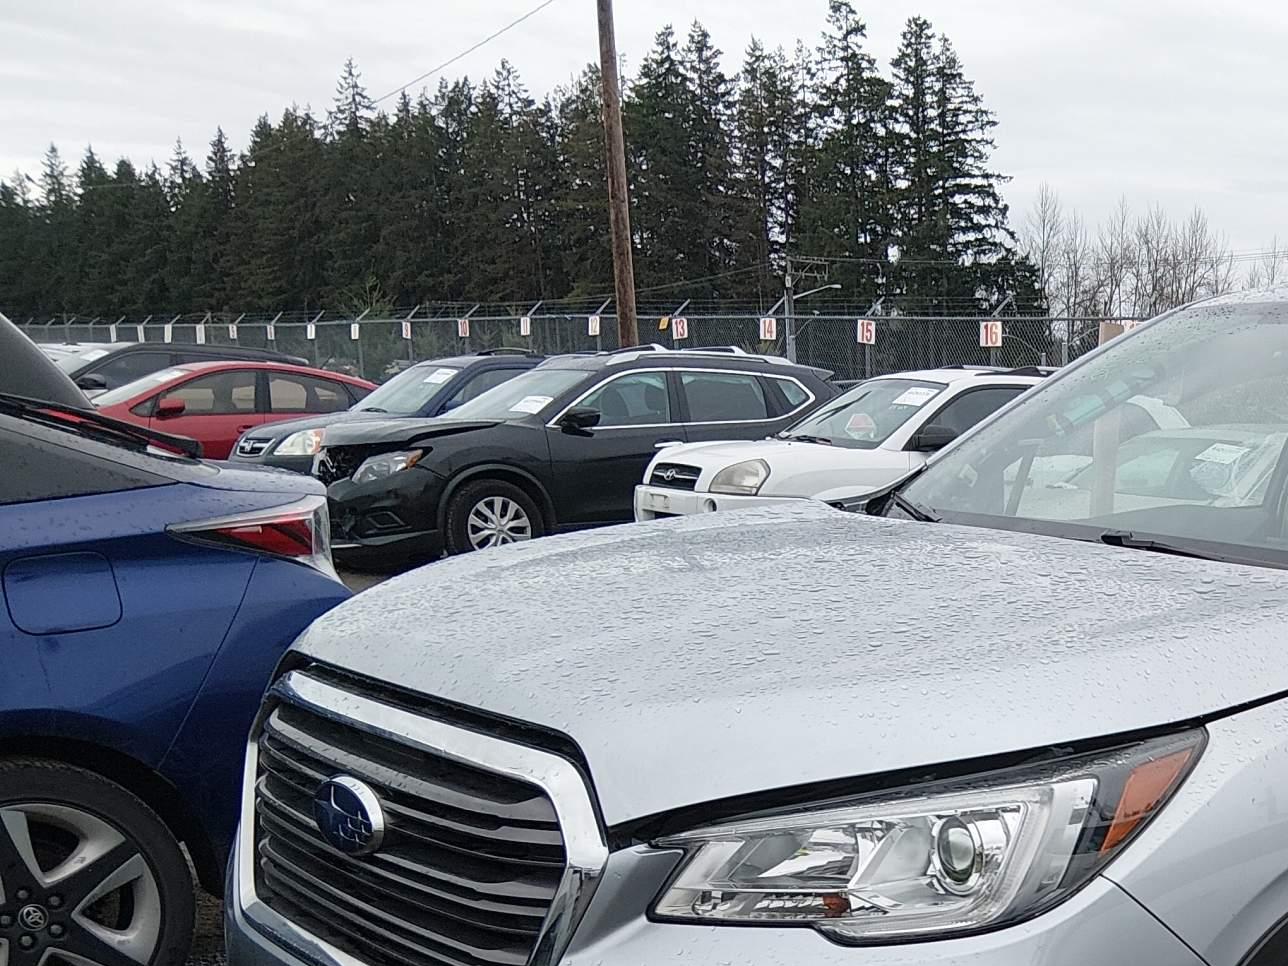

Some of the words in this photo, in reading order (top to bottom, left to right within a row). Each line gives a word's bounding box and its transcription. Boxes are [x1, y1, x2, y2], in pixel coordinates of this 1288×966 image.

[459, 319, 467, 335] 10
[675, 319, 685, 337] 13
[763, 319, 773, 338] 14
[860, 321, 872, 342] 15
[983, 322, 998, 345] 16
